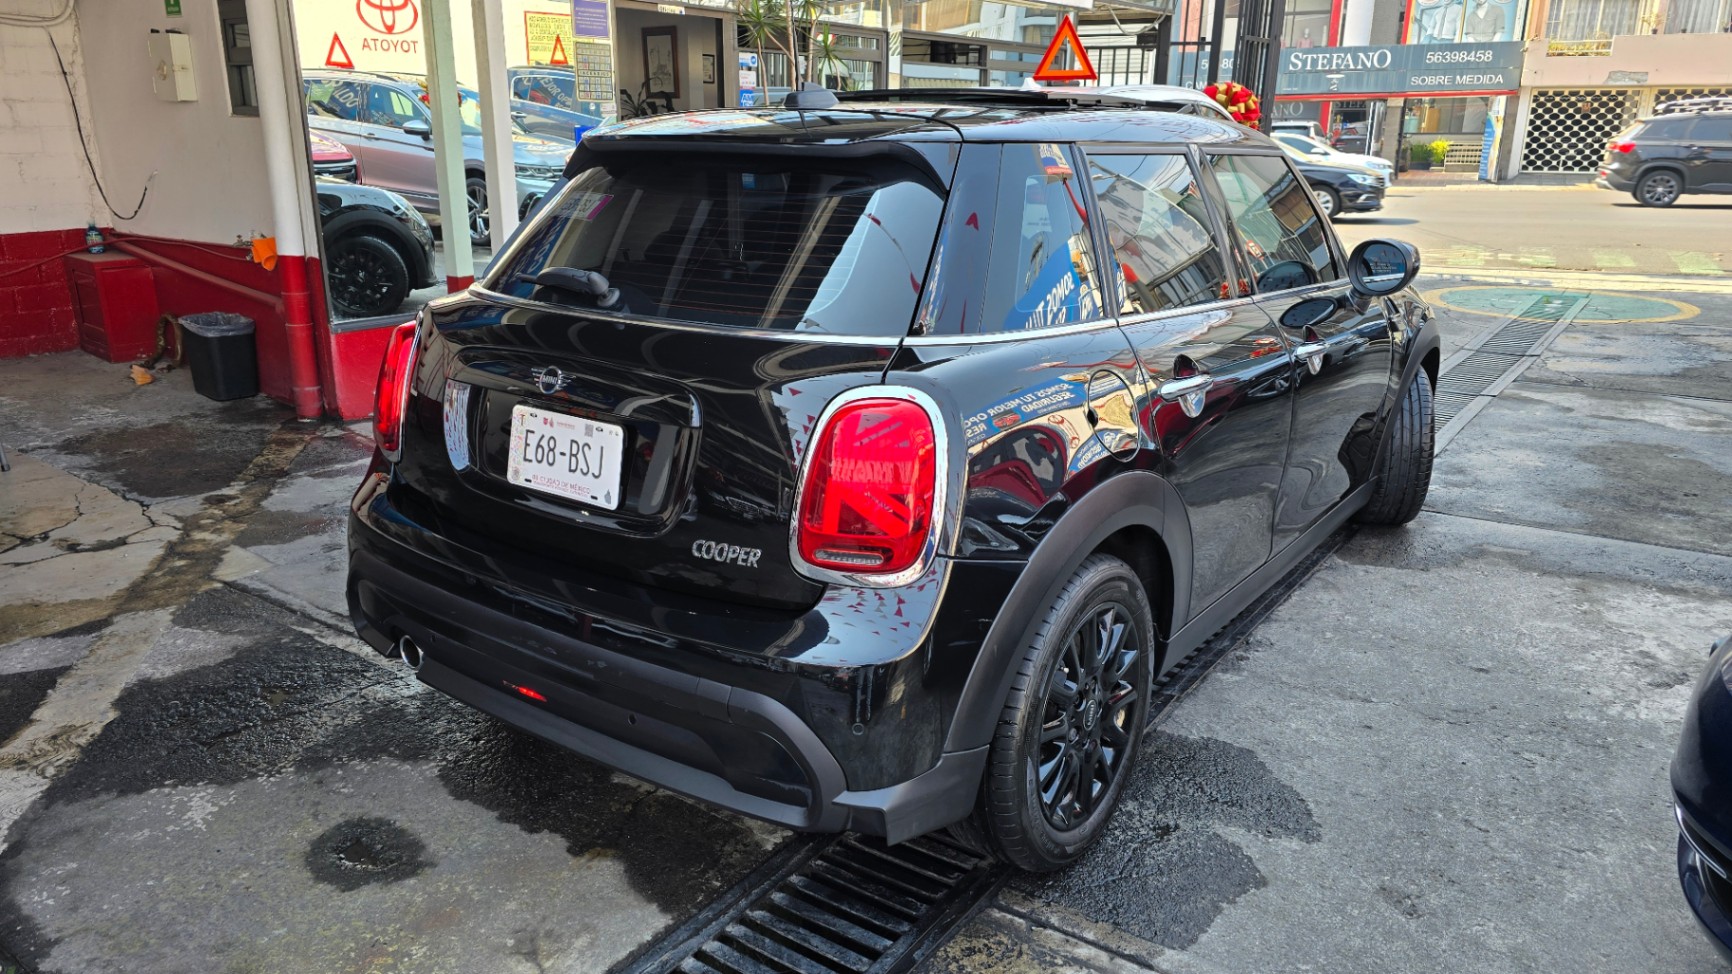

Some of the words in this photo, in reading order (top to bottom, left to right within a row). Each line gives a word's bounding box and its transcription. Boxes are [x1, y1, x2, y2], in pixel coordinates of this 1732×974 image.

[1289, 49, 1392, 71] STEFANO
[1425, 50, 1493, 64] 56398458
[1410, 75, 1453, 86] SOBRE
[1455, 74, 1504, 85] MEDIDA
[542, 375, 558, 385] MINI
[523, 429, 604, 480] E68-BSJ
[691, 539, 762, 569] COOPER
